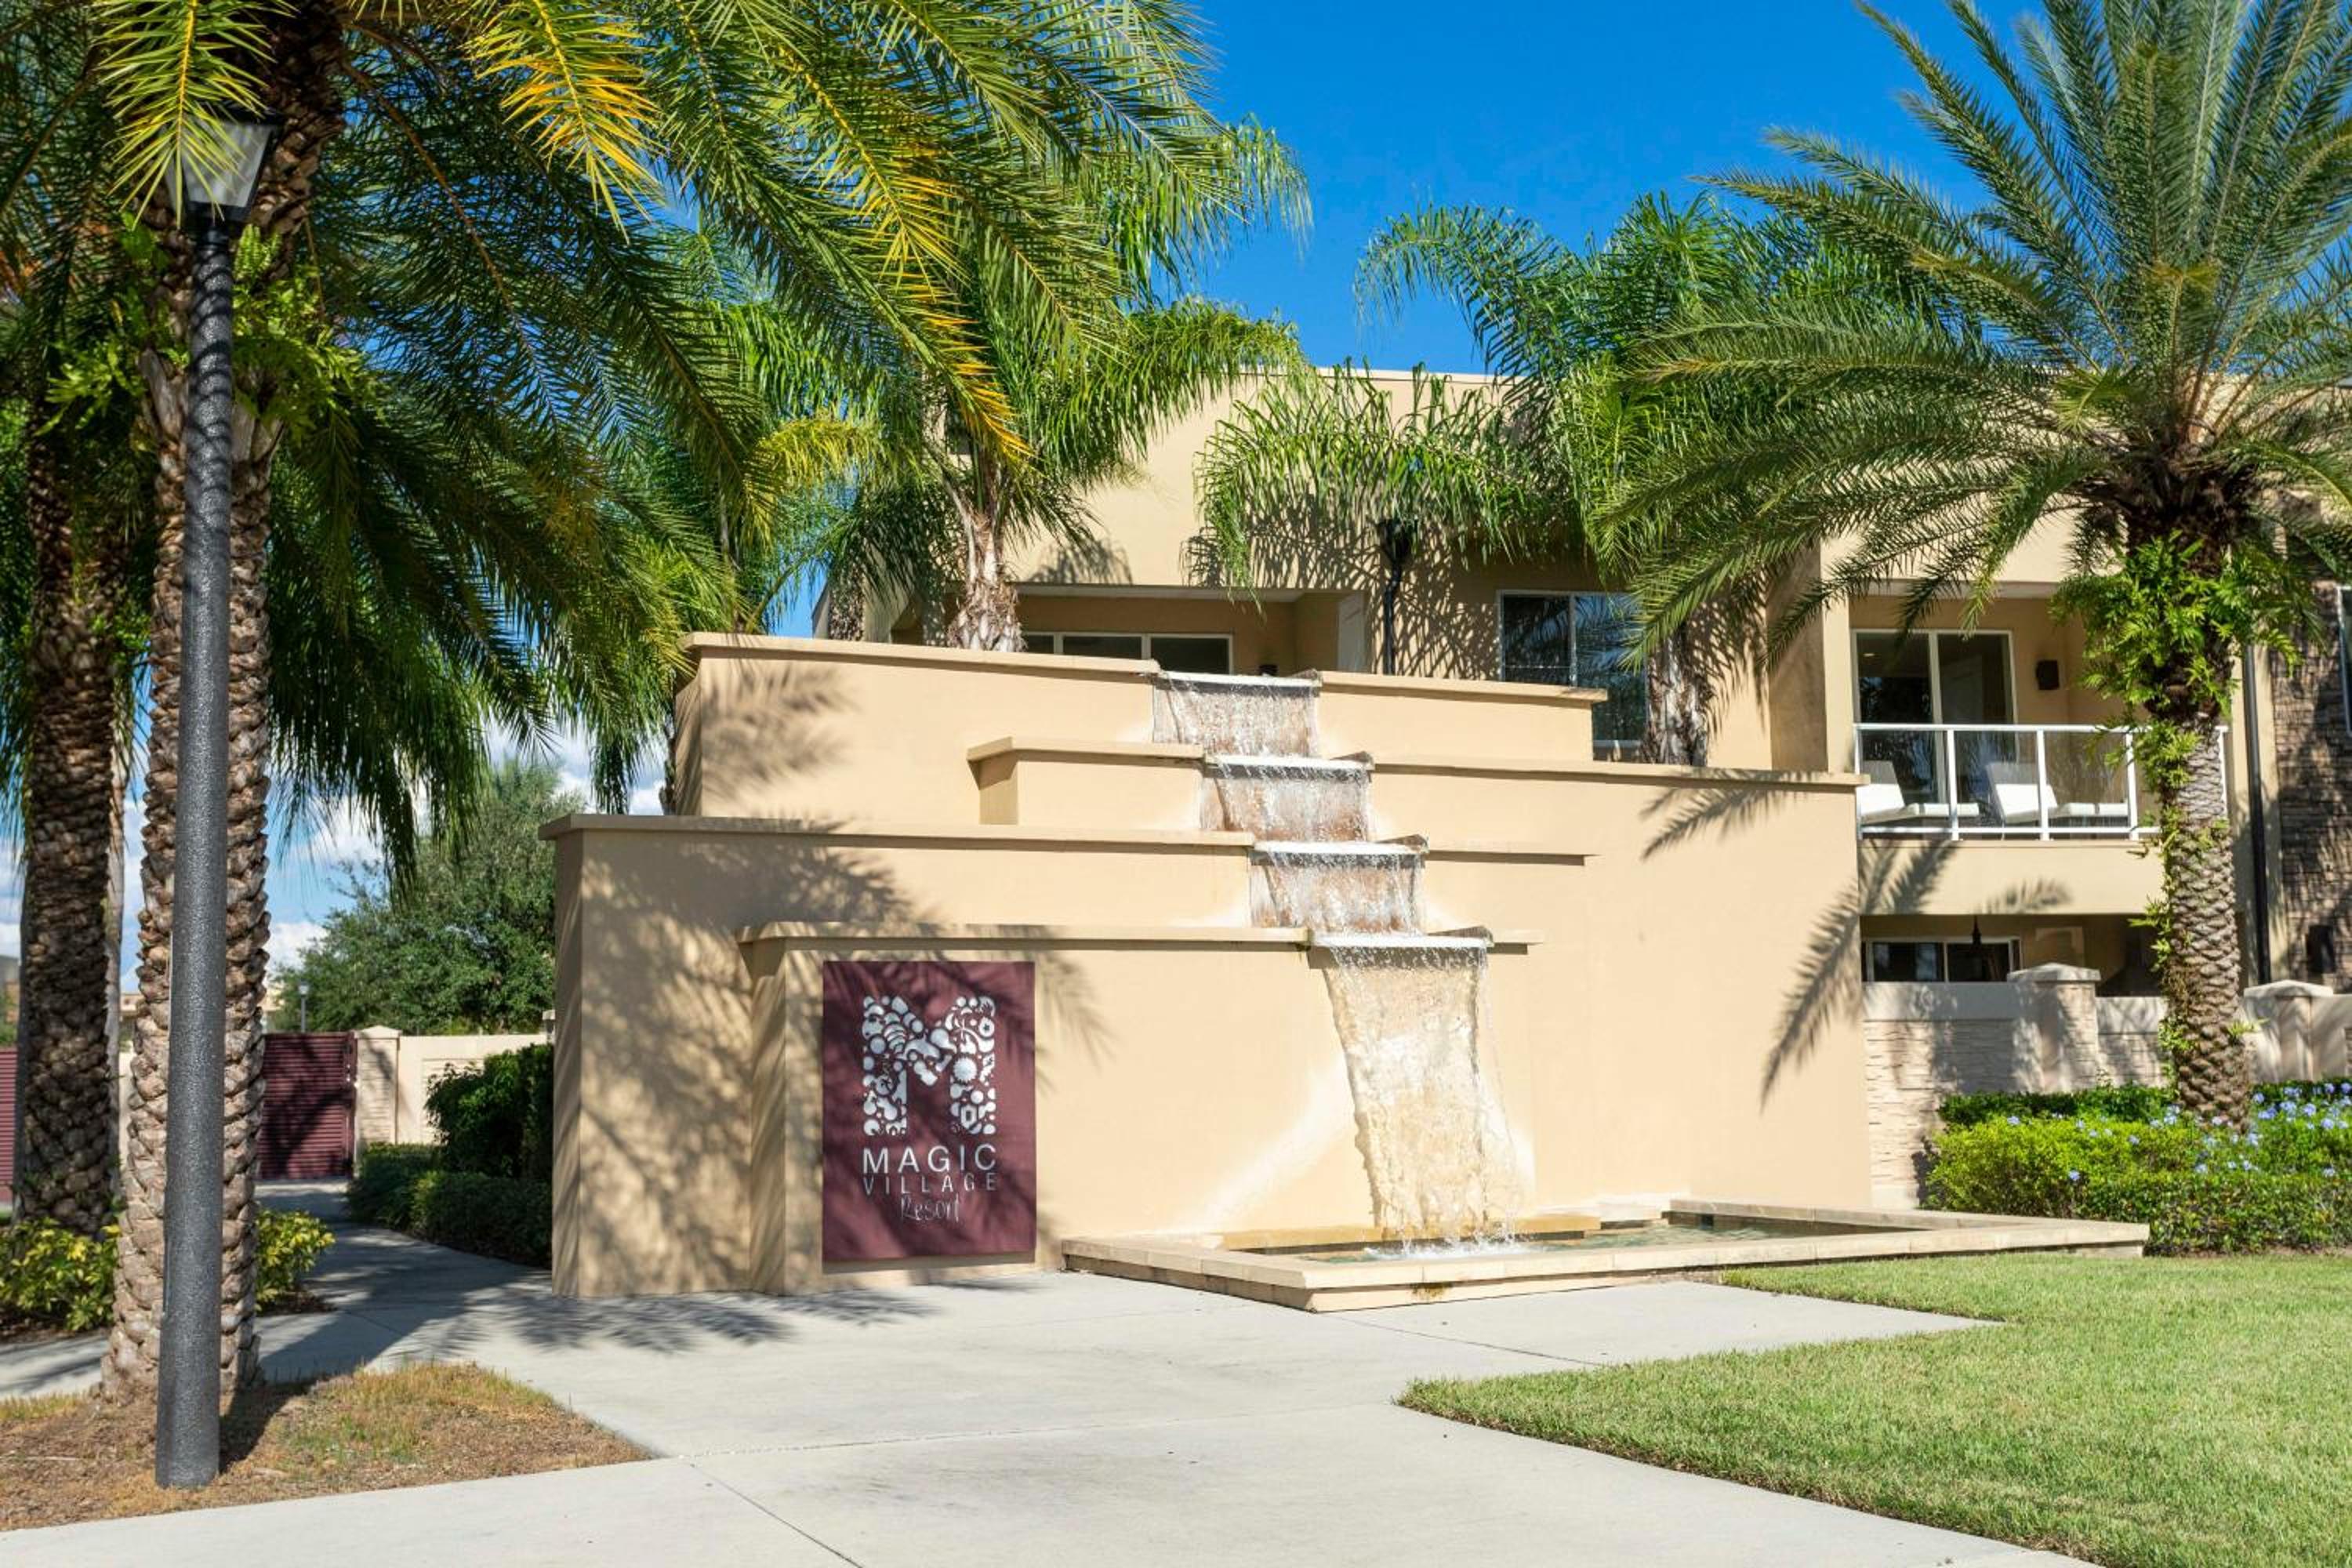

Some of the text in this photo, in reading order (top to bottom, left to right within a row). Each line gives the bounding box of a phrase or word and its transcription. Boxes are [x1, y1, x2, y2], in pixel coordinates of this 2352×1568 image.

[862, 1143, 997, 1174] MAGIC
[863, 1171, 998, 1196] VILLAGE
[900, 1192, 961, 1223] Resort
